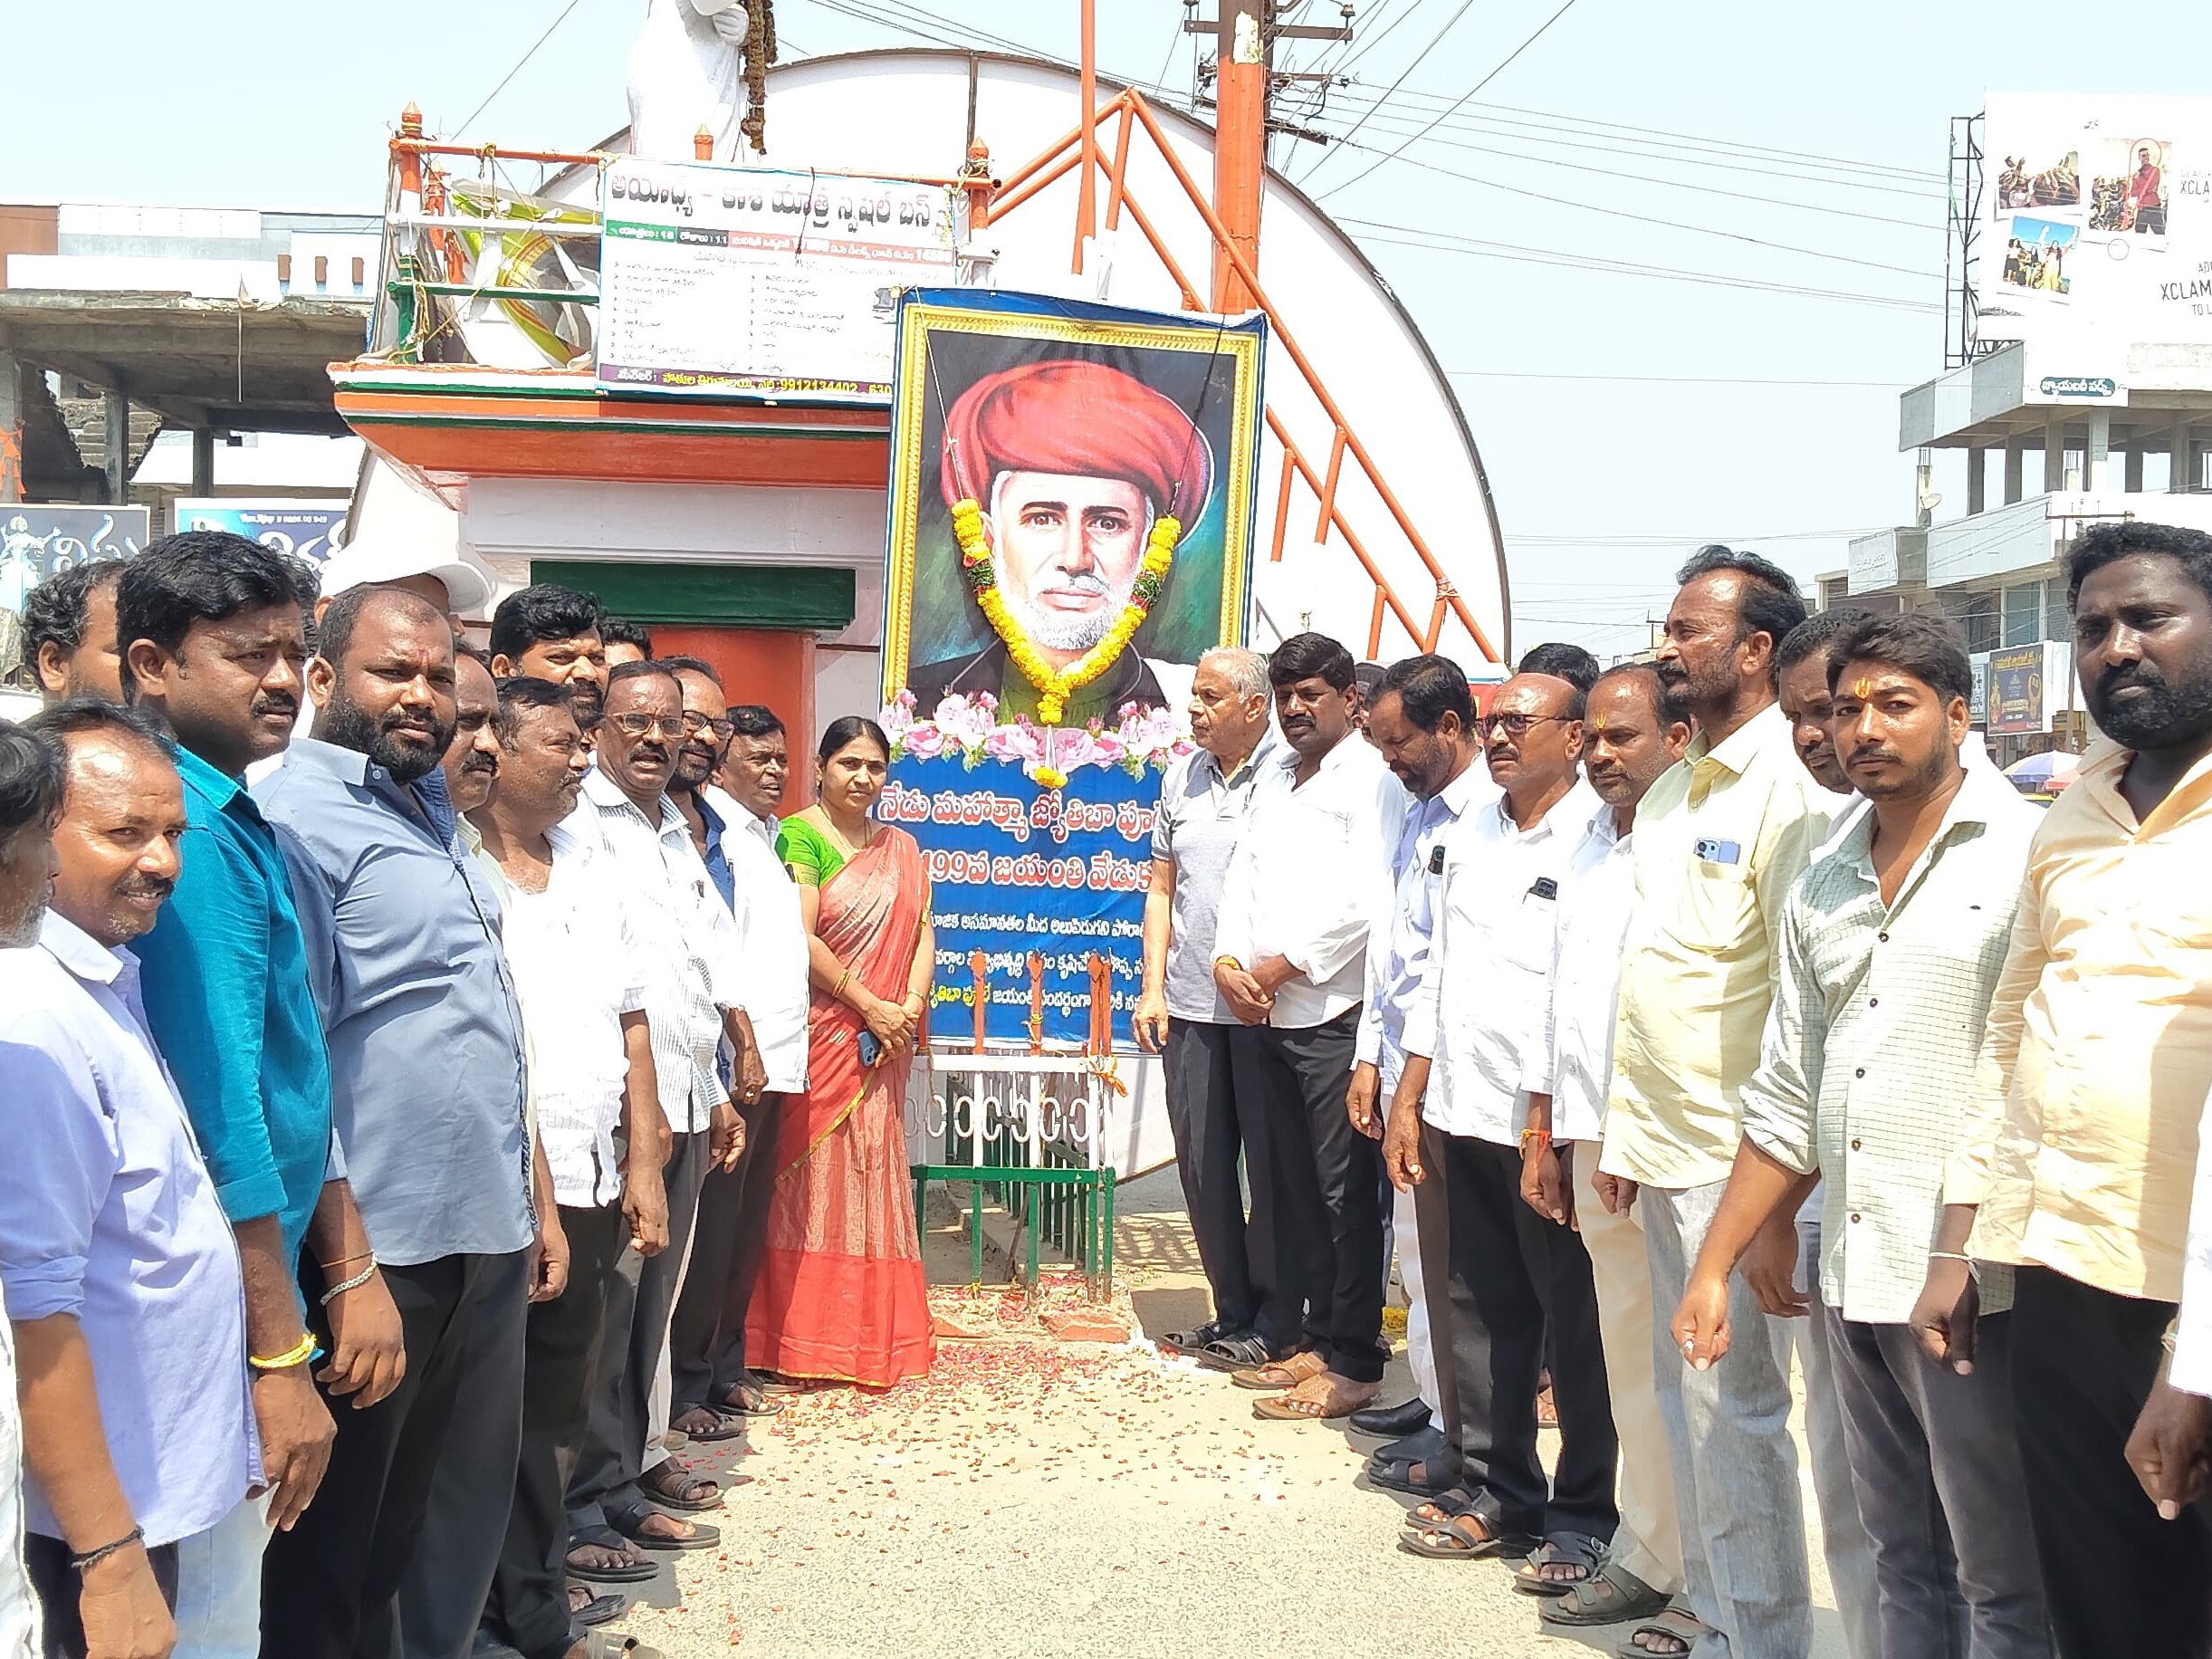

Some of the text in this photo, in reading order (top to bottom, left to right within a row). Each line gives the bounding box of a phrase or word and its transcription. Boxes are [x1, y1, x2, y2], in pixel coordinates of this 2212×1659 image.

[878, 781, 930, 821] నేడు
[933, 790, 1029, 842] మహాత్మా
[1030, 789, 1116, 843] జ్యోతిబా
[991, 852, 1086, 889] జయంతి
[1026, 912, 1048, 934] మీద
